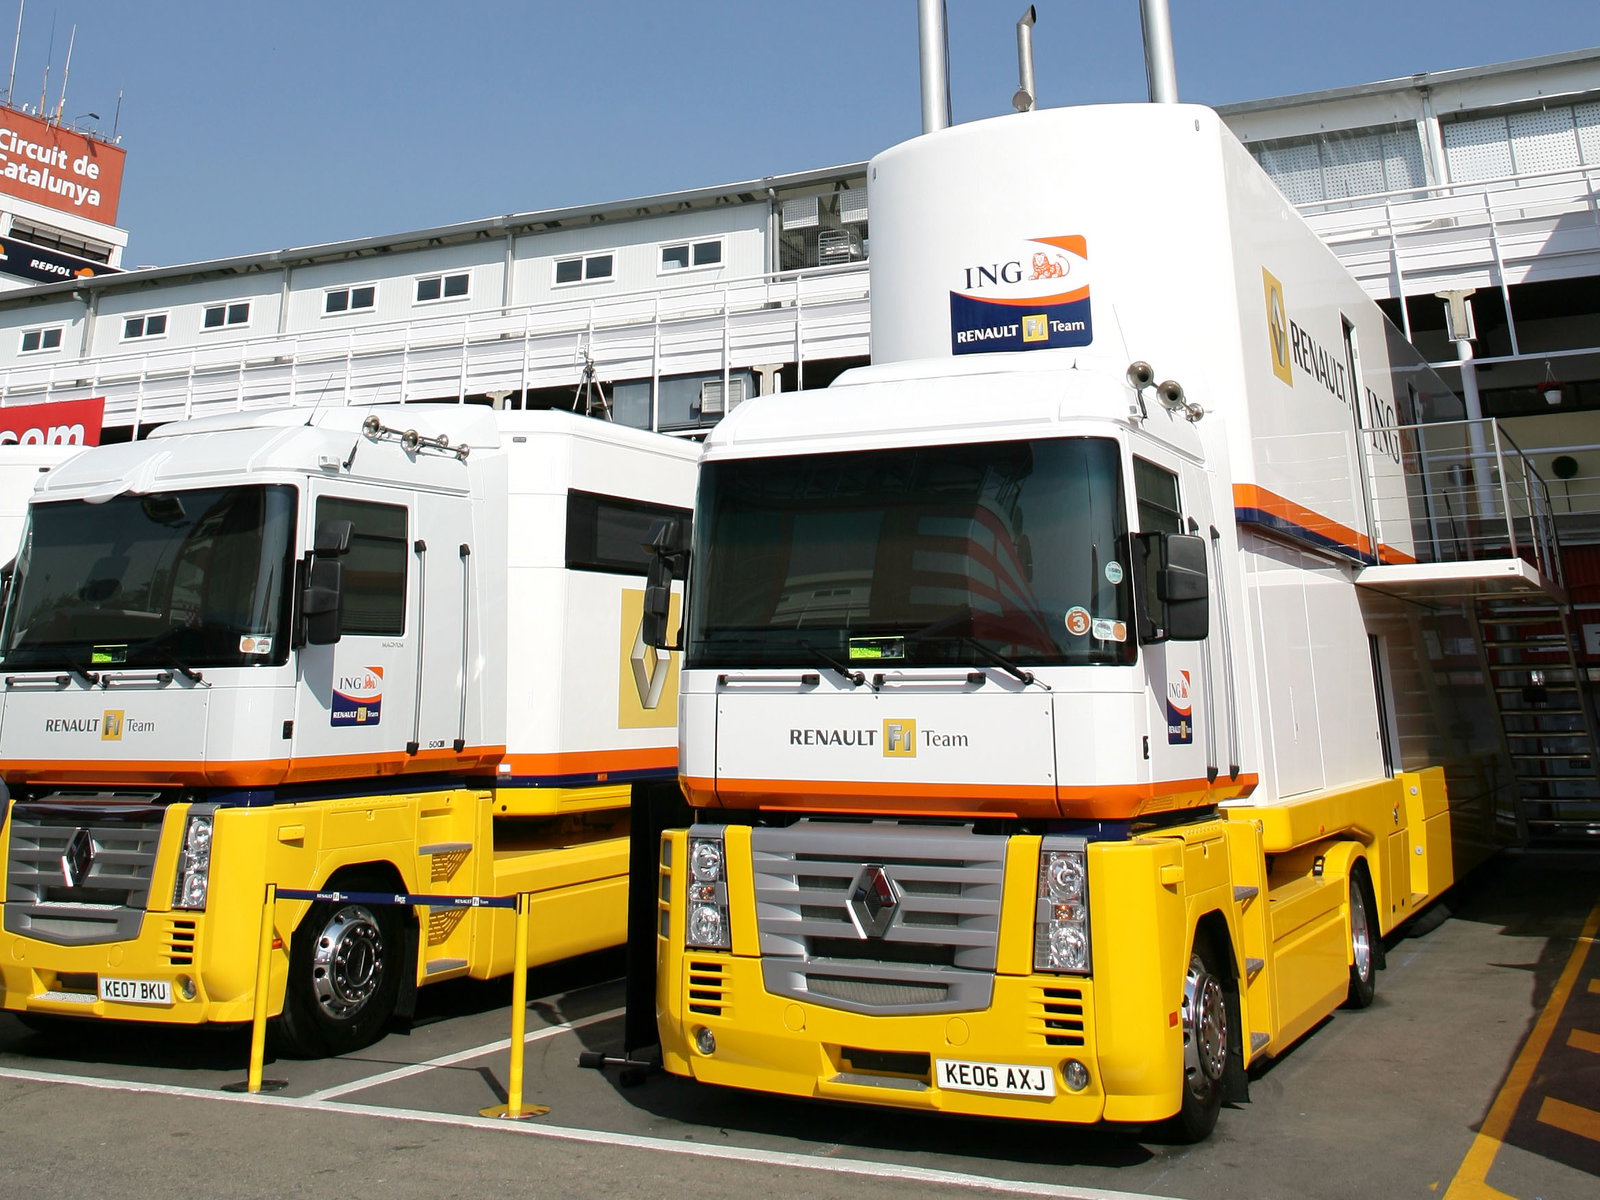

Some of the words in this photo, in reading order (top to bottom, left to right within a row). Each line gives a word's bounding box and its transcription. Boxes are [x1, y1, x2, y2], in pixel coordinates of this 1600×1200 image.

[0, 128, 68, 170] Circuit
[73, 155, 100, 180] de
[30, 259, 71, 277] REPSOL
[964, 261, 1023, 290] ING
[957, 324, 1019, 344] RENAULT
[1049, 320, 1085, 333] Team
[1289, 318, 1346, 404] RENAULT
[1366, 386, 1400, 465] ING
[339, 677, 362, 690] ING
[45, 719, 100, 733] RENAULT
[126, 718, 155, 732] Team
[789, 729, 878, 747] RENAULT
[887, 724, 911, 752] F1
[921, 730, 968, 747] Team
[105, 981, 137, 998] KE07
[140, 983, 166, 1000] BKU
[945, 1063, 998, 1088] KE06
[1006, 1068, 1046, 1091] AXJ
